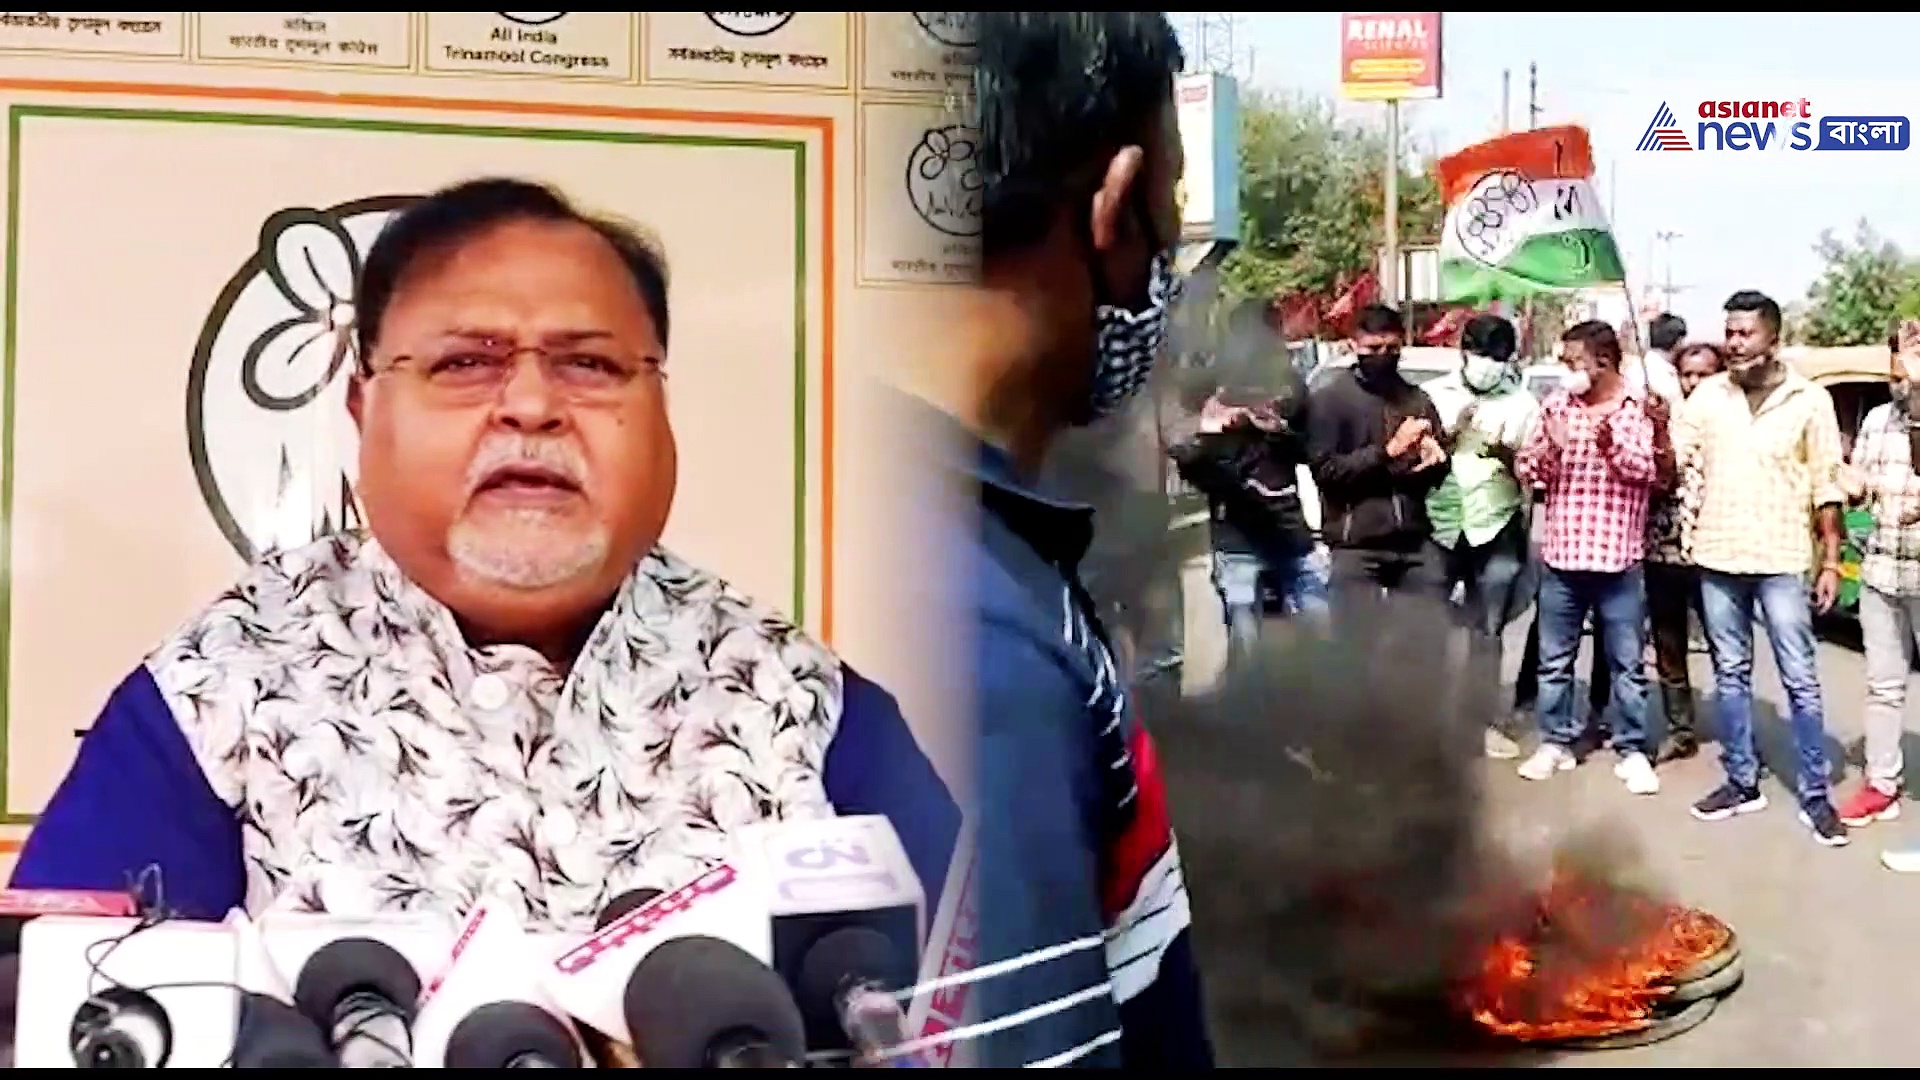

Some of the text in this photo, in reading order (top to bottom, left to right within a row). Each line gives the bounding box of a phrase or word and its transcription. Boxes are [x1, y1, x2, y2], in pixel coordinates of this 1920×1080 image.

[491, 27, 557, 44] All India
[1347, 19, 1428, 40] RENAL
[443, 45, 609, 68] Trinamool Congress
